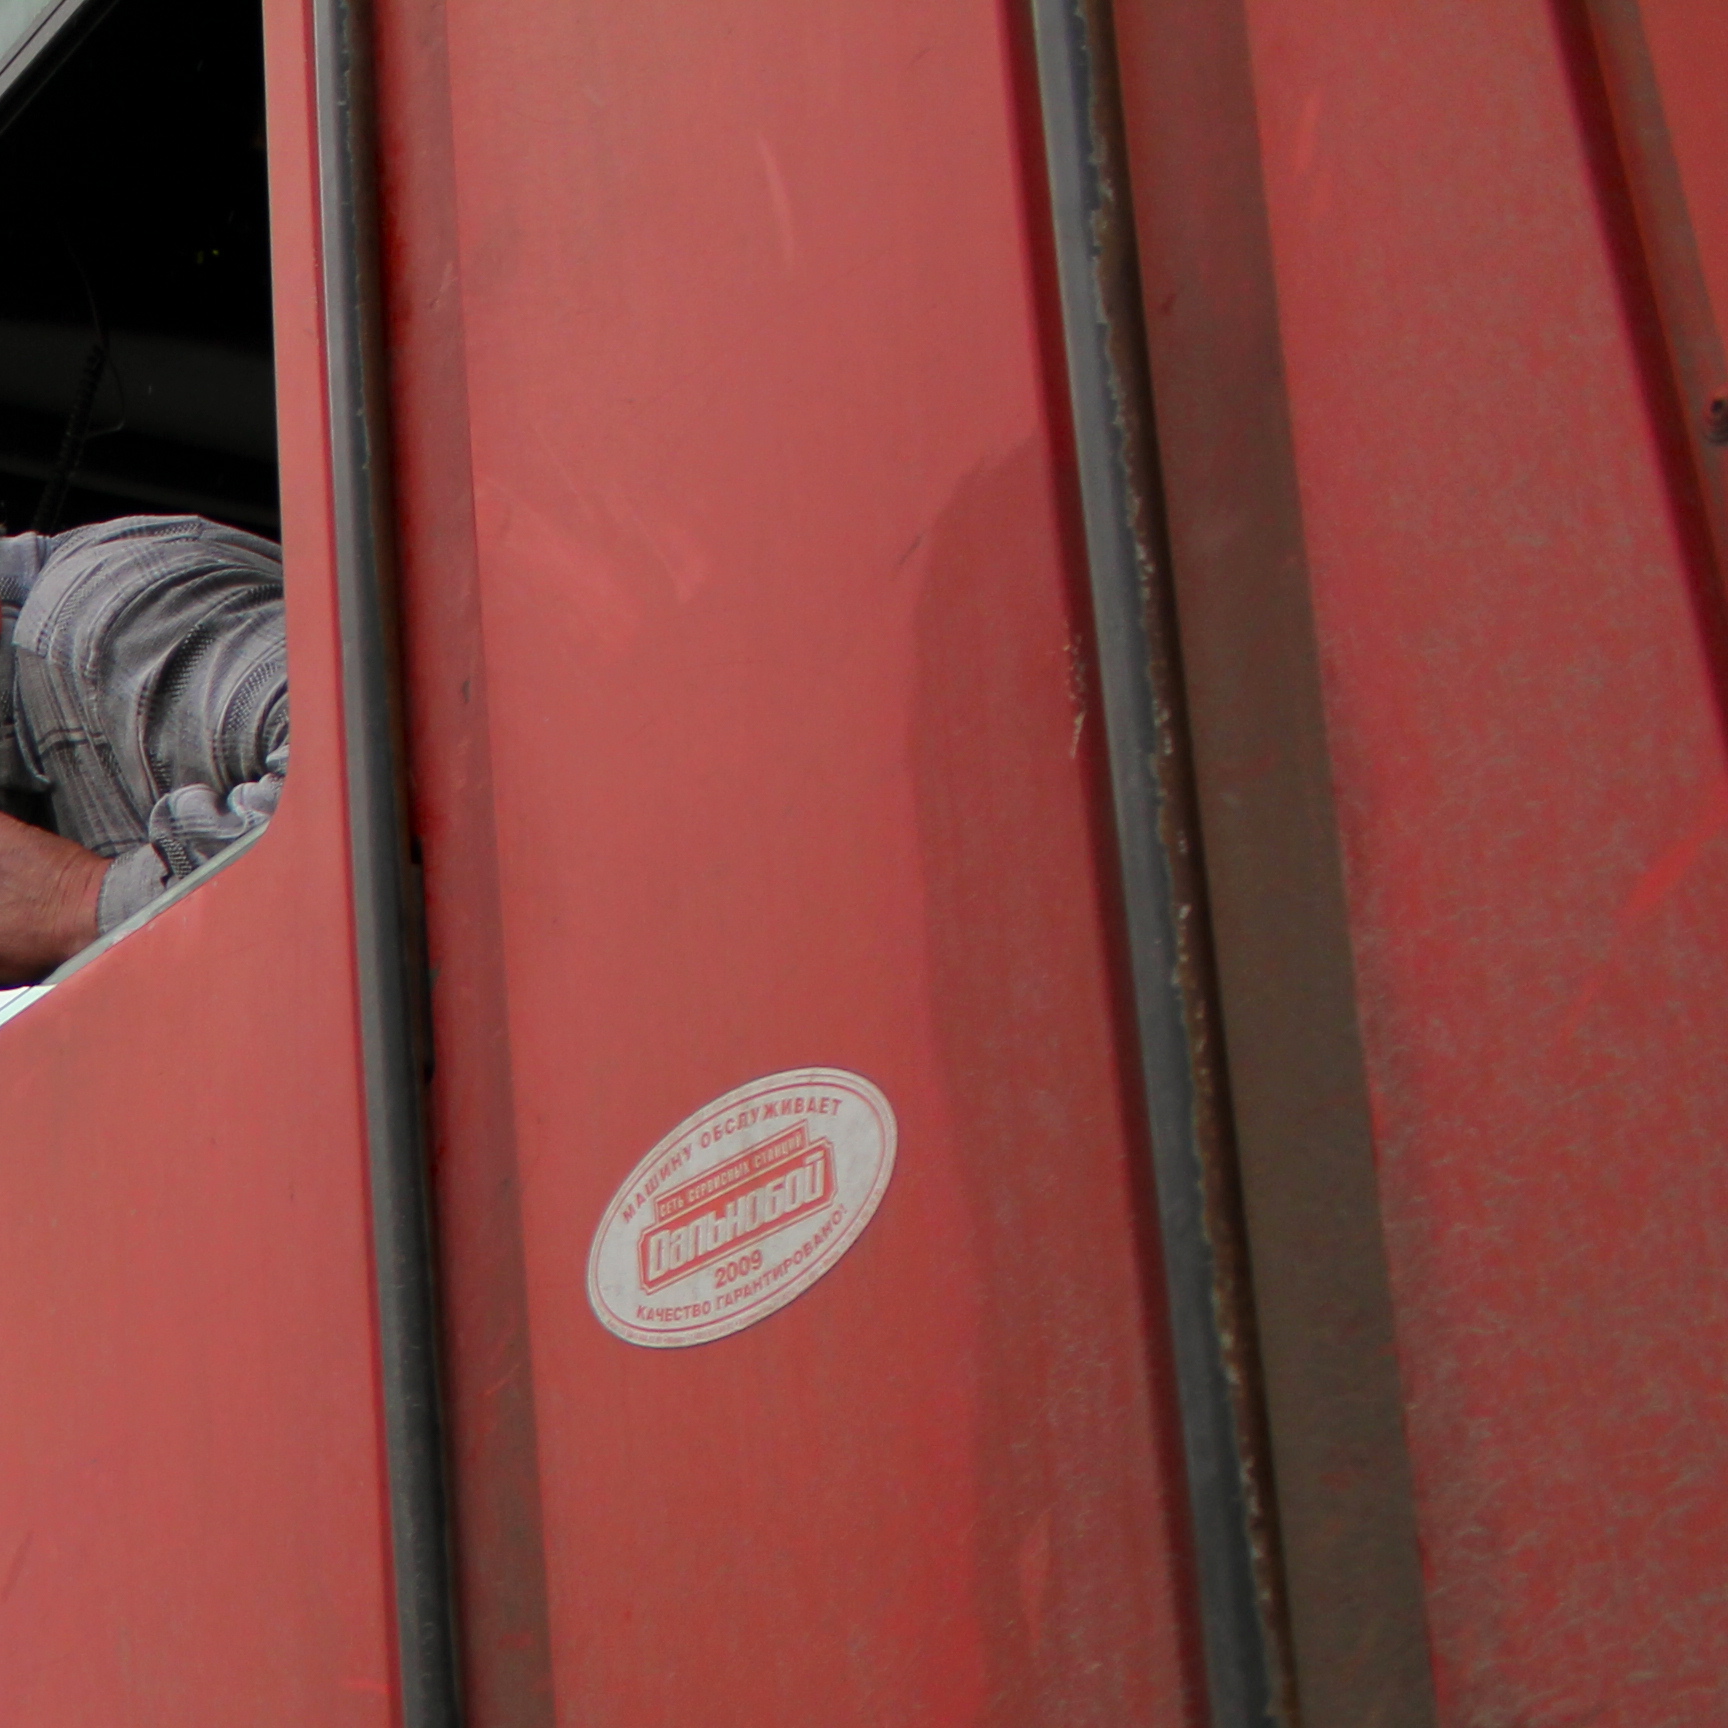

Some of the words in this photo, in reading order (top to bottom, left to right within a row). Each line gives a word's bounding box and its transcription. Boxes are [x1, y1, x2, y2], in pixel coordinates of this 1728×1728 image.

[622, 1143, 693, 1224] МАШИНУ
[700, 1096, 843, 1149] ОБСЛУЖИВАЕТ
[714, 1249, 763, 1289] 2009
[636, 1300, 712, 1323] КАЧЕСТВО
